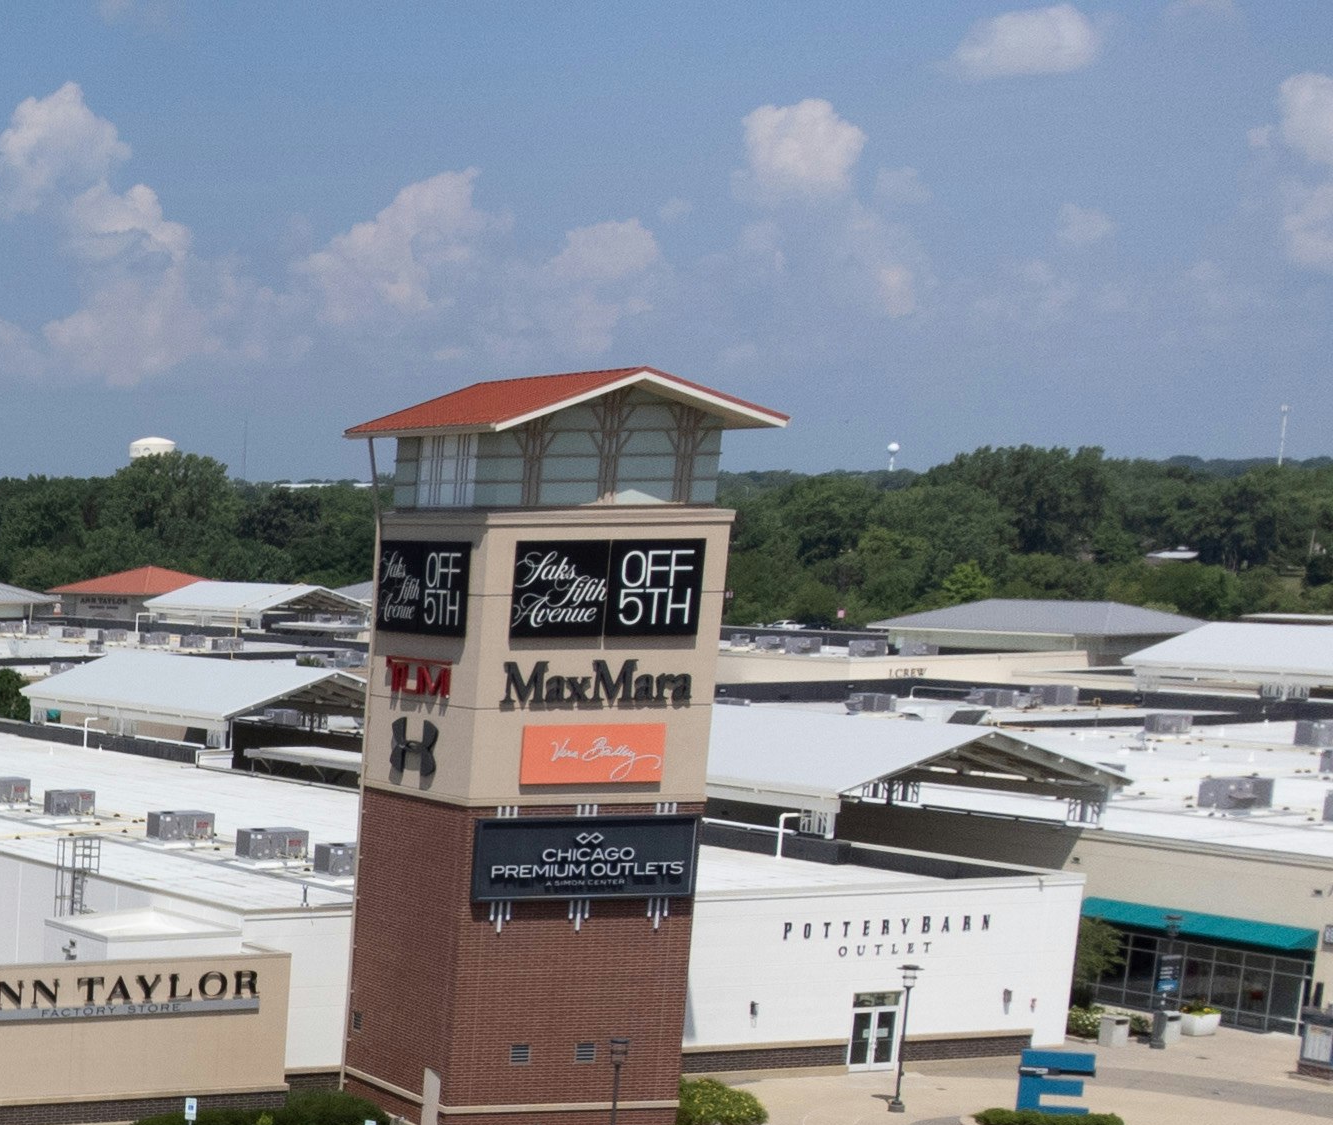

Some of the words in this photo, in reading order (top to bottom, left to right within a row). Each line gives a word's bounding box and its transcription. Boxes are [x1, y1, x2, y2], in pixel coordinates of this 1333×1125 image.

[426, 552, 462, 588] OFF
[515, 551, 577, 589] Saks
[621, 550, 695, 587] OFF
[424, 589, 460, 625] 5TH
[511, 593, 597, 627] Avenue
[619, 588, 692, 625] 5TH
[491, 864, 585, 878] PREMIUM
[542, 847, 635, 862] CHICAGO
[587, 878, 626, 886] CENTER
[838, 941, 932, 957] OUTLET
[77, 970, 261, 1005] TAYLOR
[41, 1004, 117, 1018] FACTORY
[127, 1002, 181, 1014] STORE
